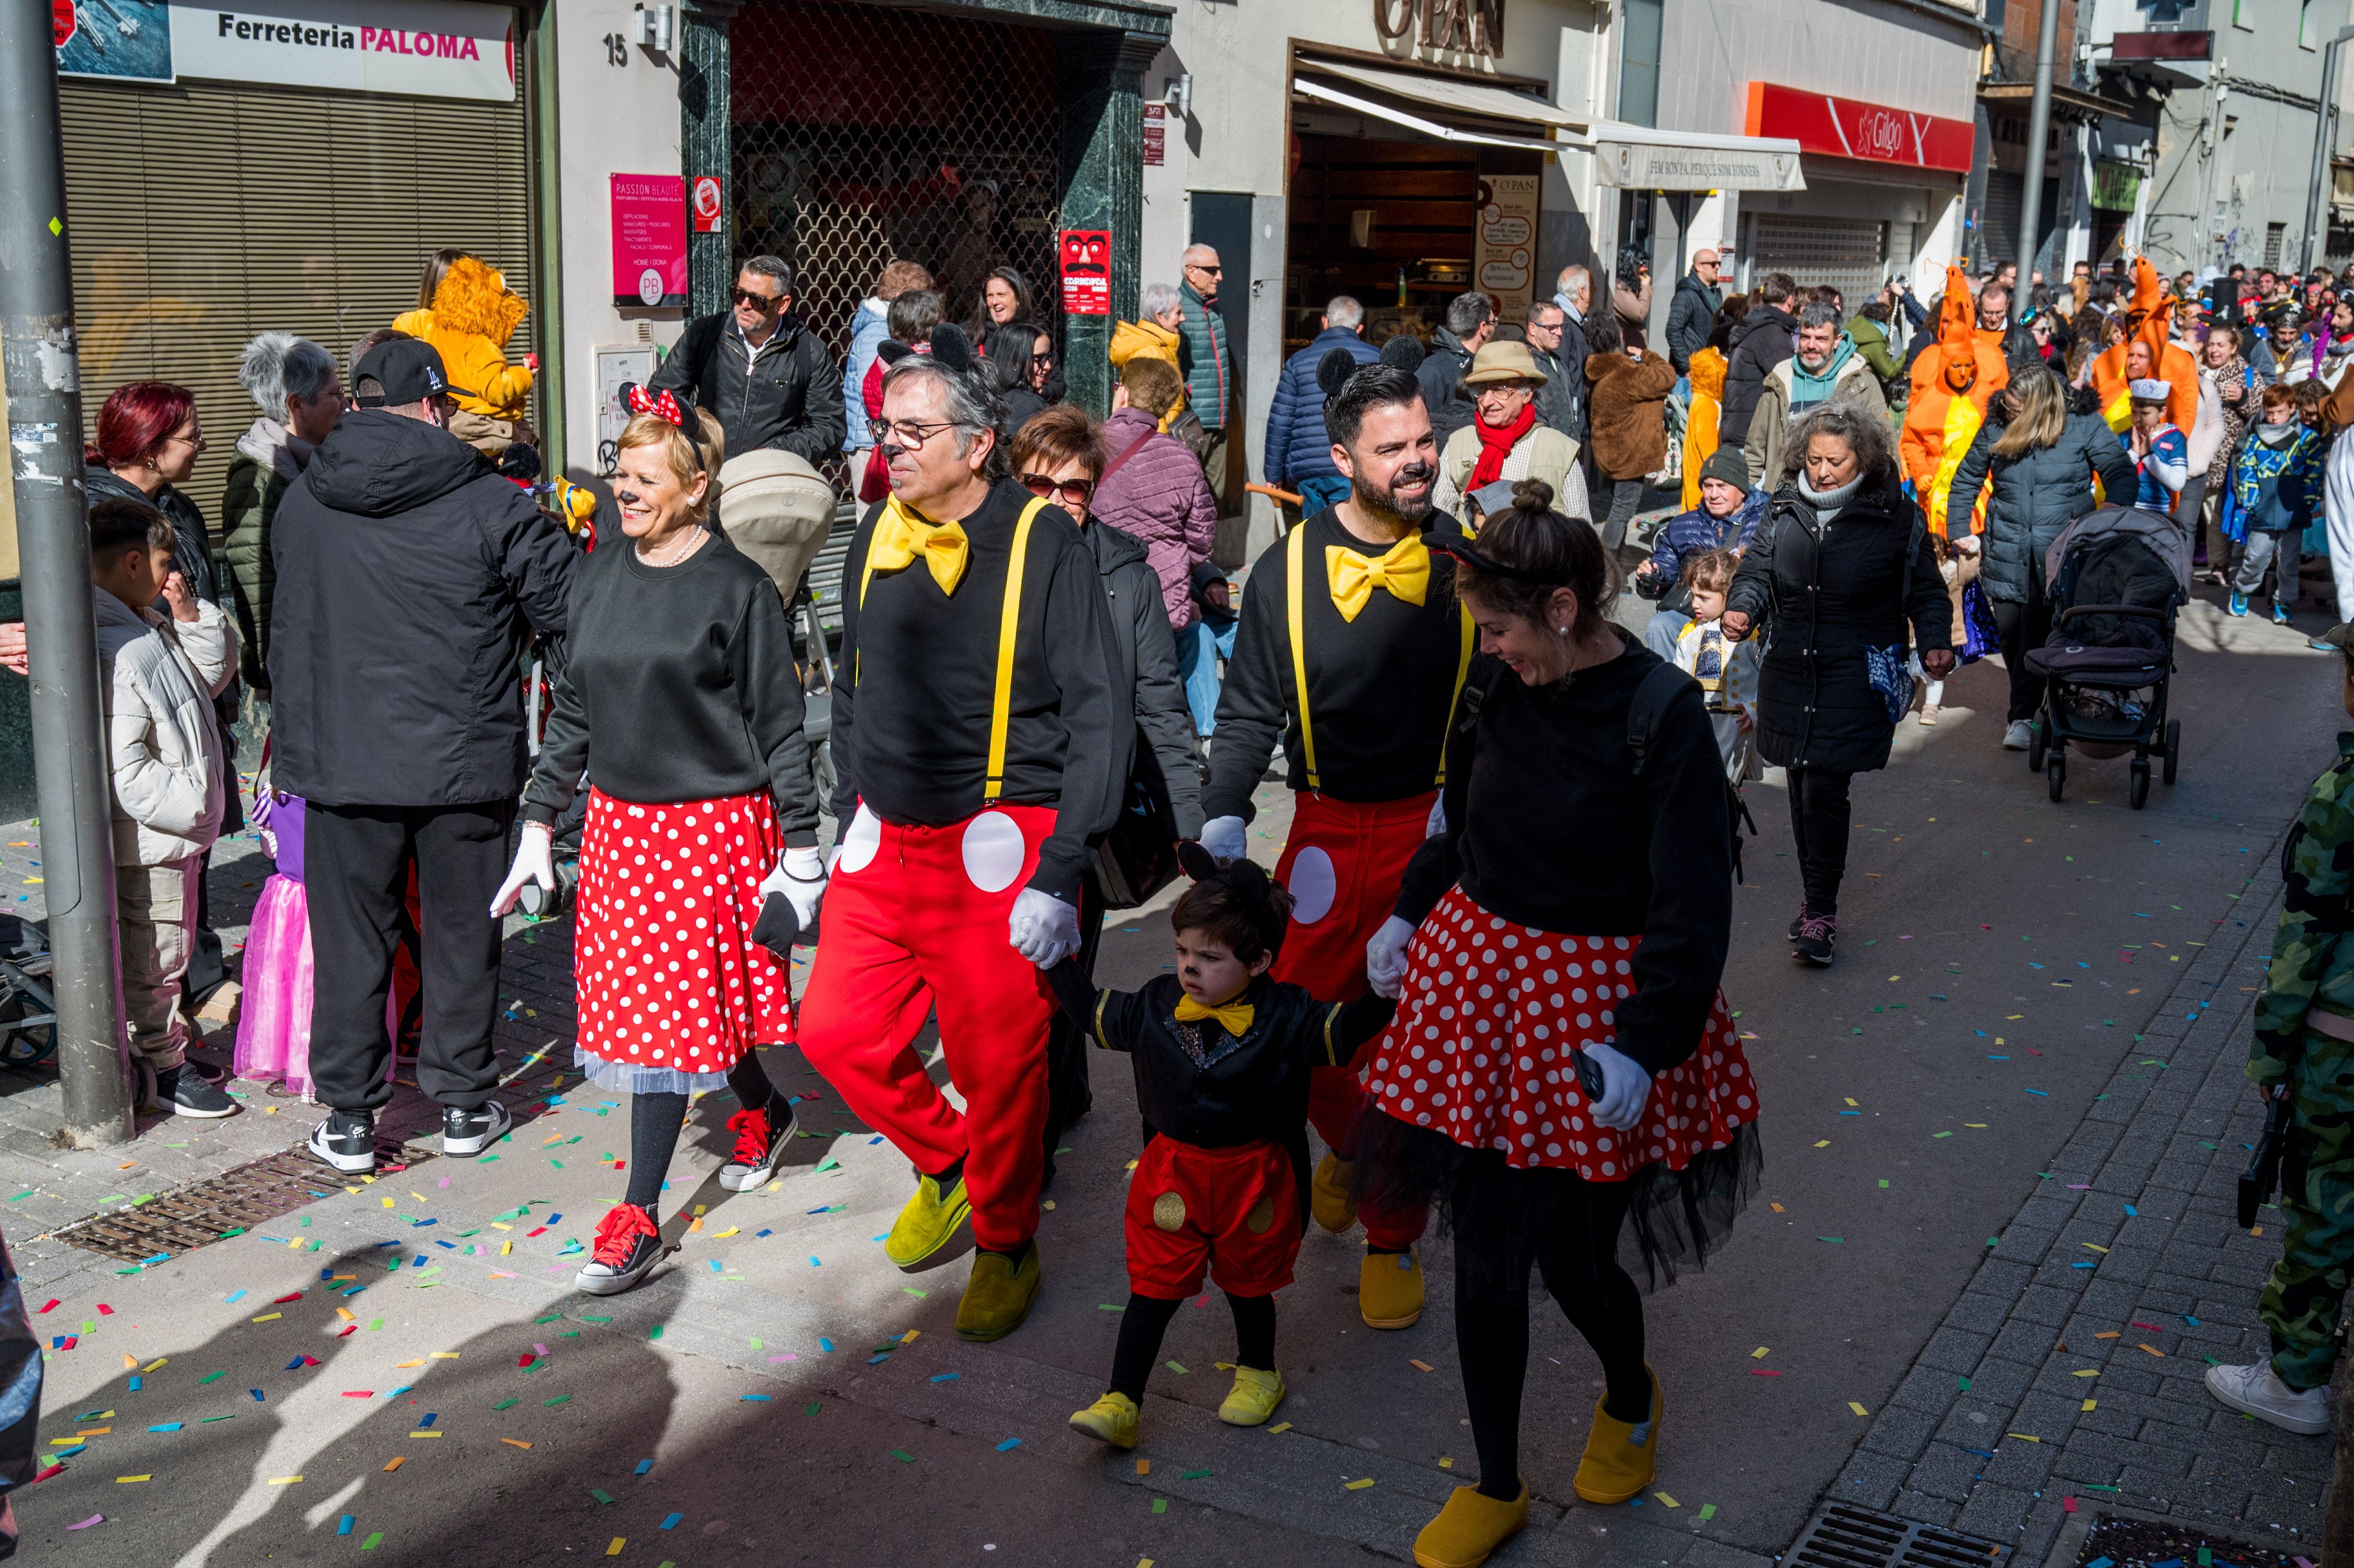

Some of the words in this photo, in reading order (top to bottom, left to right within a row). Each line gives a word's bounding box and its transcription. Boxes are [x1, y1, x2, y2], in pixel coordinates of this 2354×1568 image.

[218, 13, 354, 49] Ferreteria
[360, 26, 479, 61] PALOMA
[603, 33, 625, 67] 15
[1873, 111, 1901, 158] Gilgo
[1651, 161, 1664, 174] FEM
[1665, 162, 1678, 175] BON
[1680, 162, 1689, 175] PA,
[1691, 161, 1717, 179] PERQUÈ
[1718, 164, 1731, 176] SOM
[1733, 165, 1759, 177] FORNERS
[617, 184, 649, 194] PASSION
[1500, 180, 1534, 190] O'PAN
[644, 278, 659, 294] PB
[1063, 277, 1107, 285] CARNAVAL
